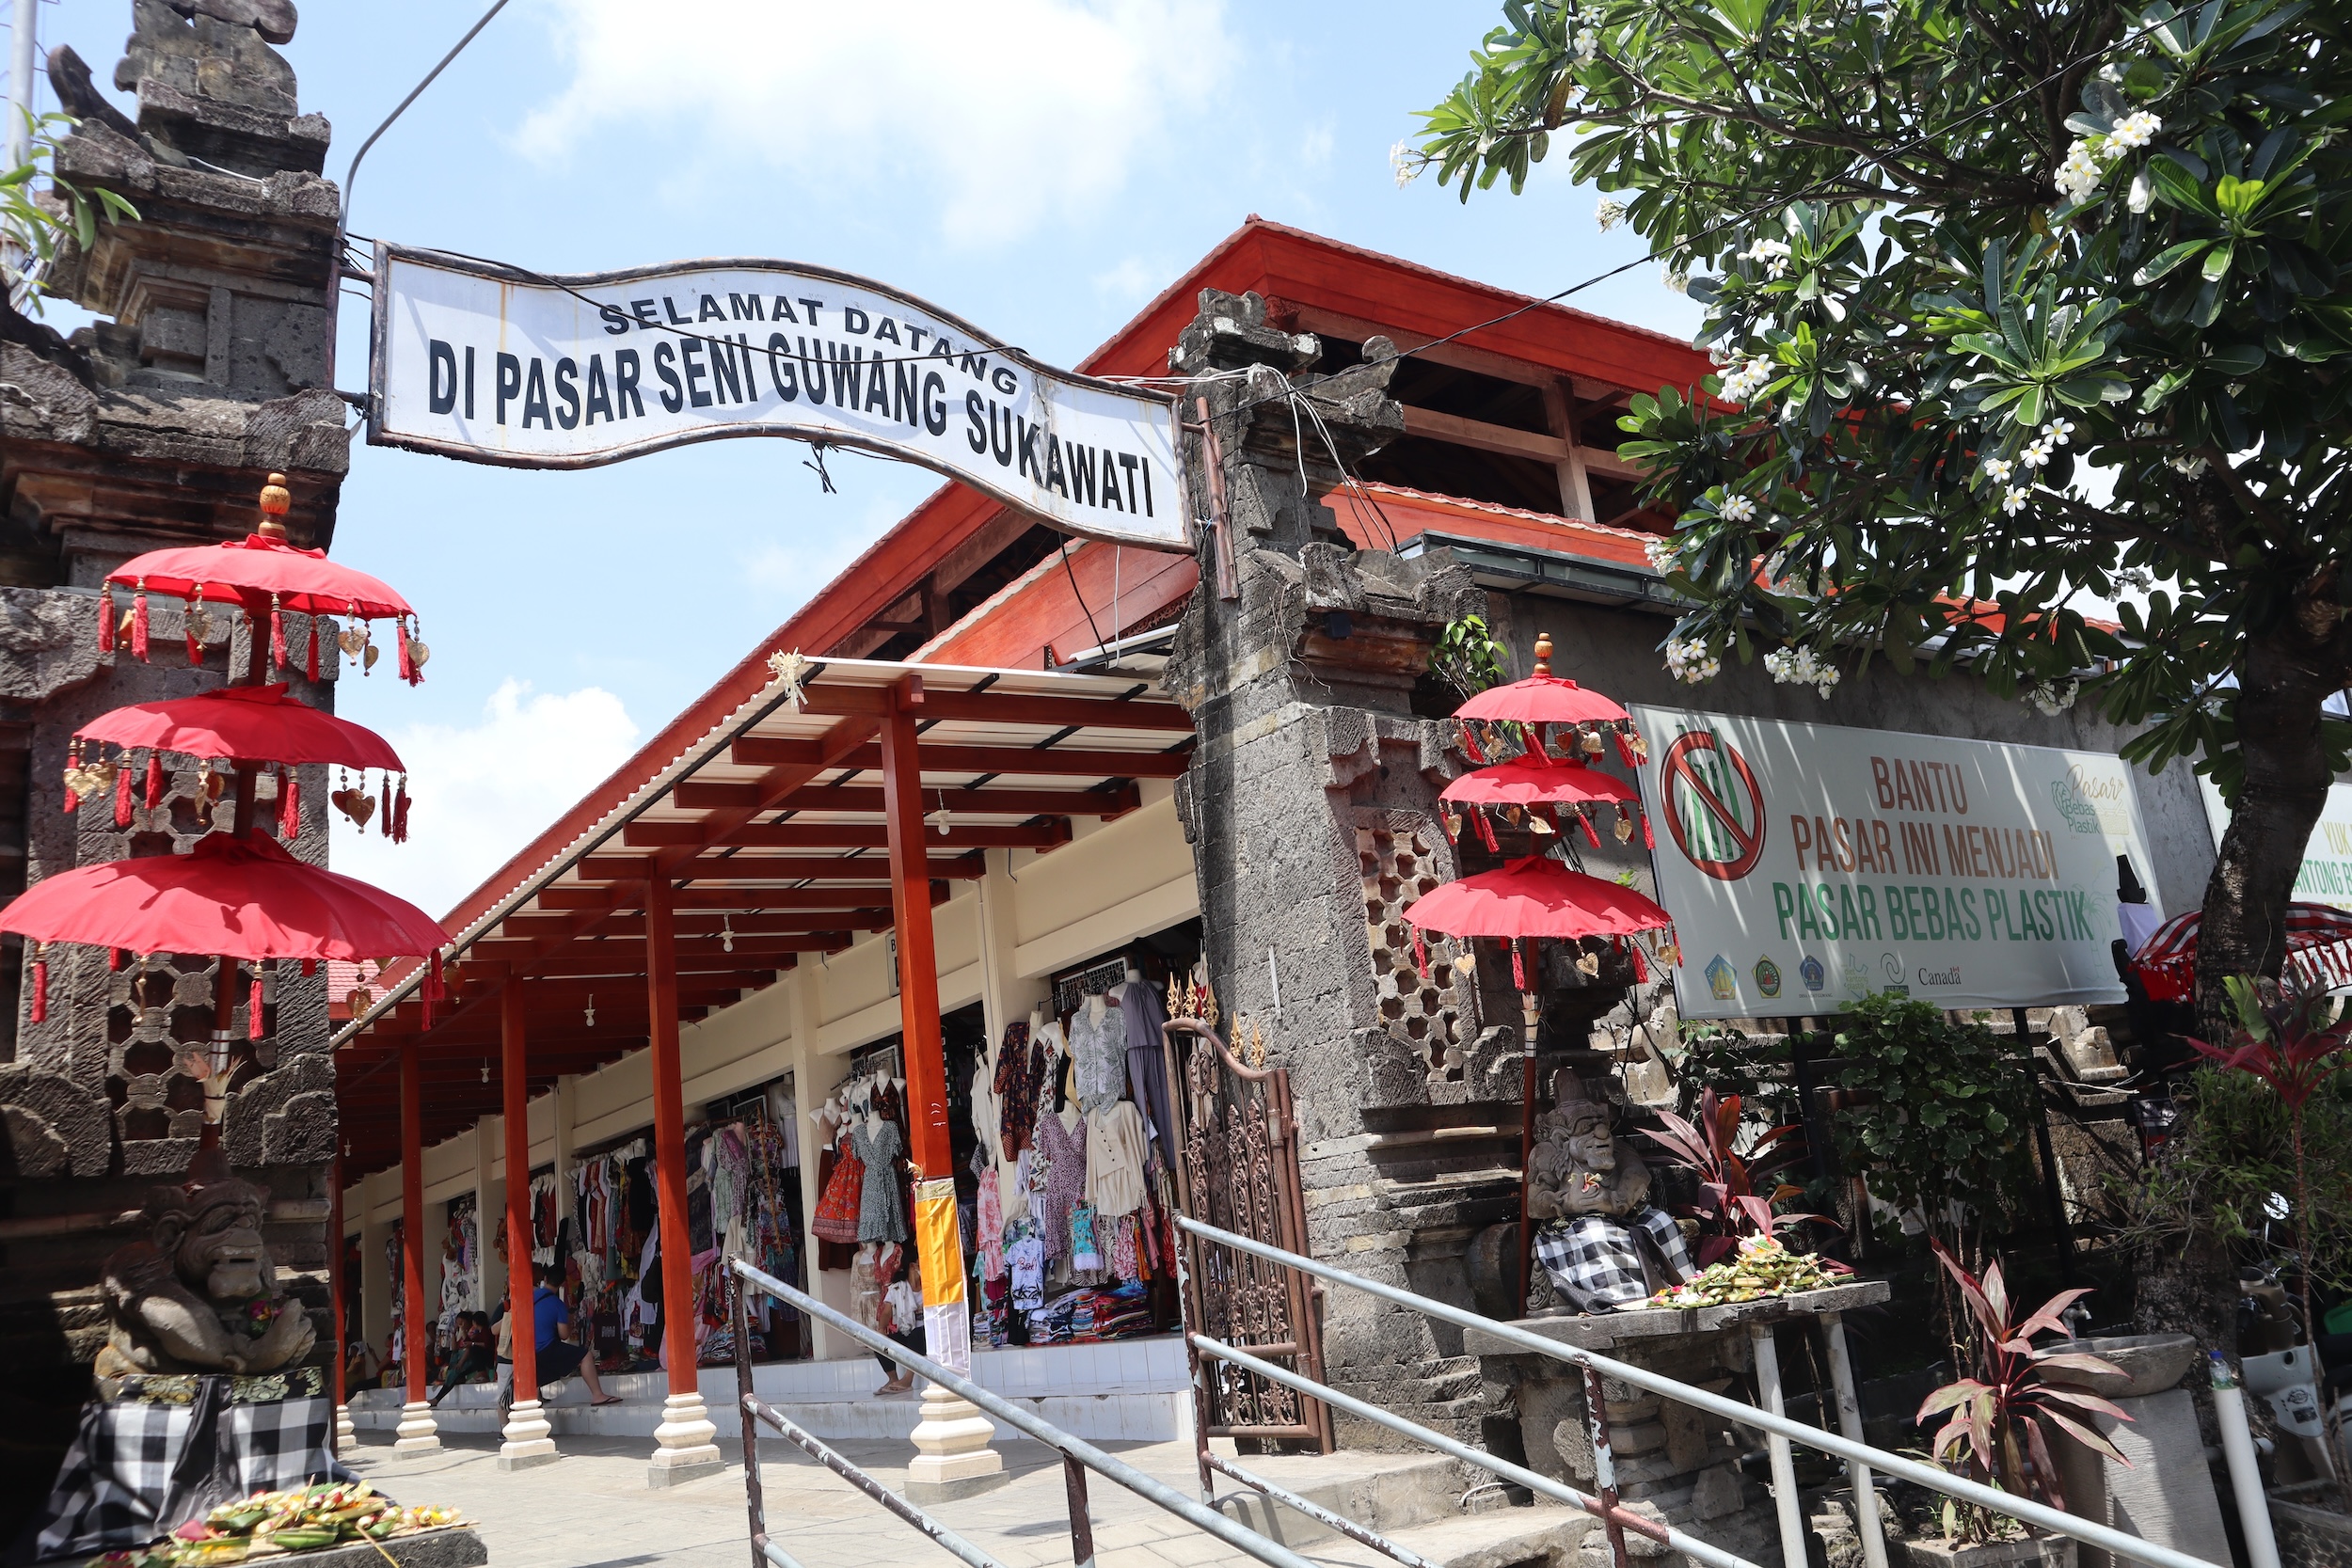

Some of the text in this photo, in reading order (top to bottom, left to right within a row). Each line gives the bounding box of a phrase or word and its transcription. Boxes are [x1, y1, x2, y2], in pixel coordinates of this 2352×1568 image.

[599, 293, 1018, 395] SELAMAT DATANG
[429, 332, 1153, 518] DI PASAR SENI GUWANG SUKAWATI
[1870, 756, 1968, 816] BANTU
[2065, 763, 2123, 801] Pasar
[2065, 799, 2096, 816] Bebas
[2067, 816, 2101, 834] Plastik
[1790, 815, 2059, 880] PASAR INI MENJADI
[2321, 821, 2352, 855] YUK
[2293, 860, 2344, 895] ANTONG
[1772, 882, 2095, 941] PASAR BEBAS PLASTIK
[1918, 967, 1963, 986] Canada
